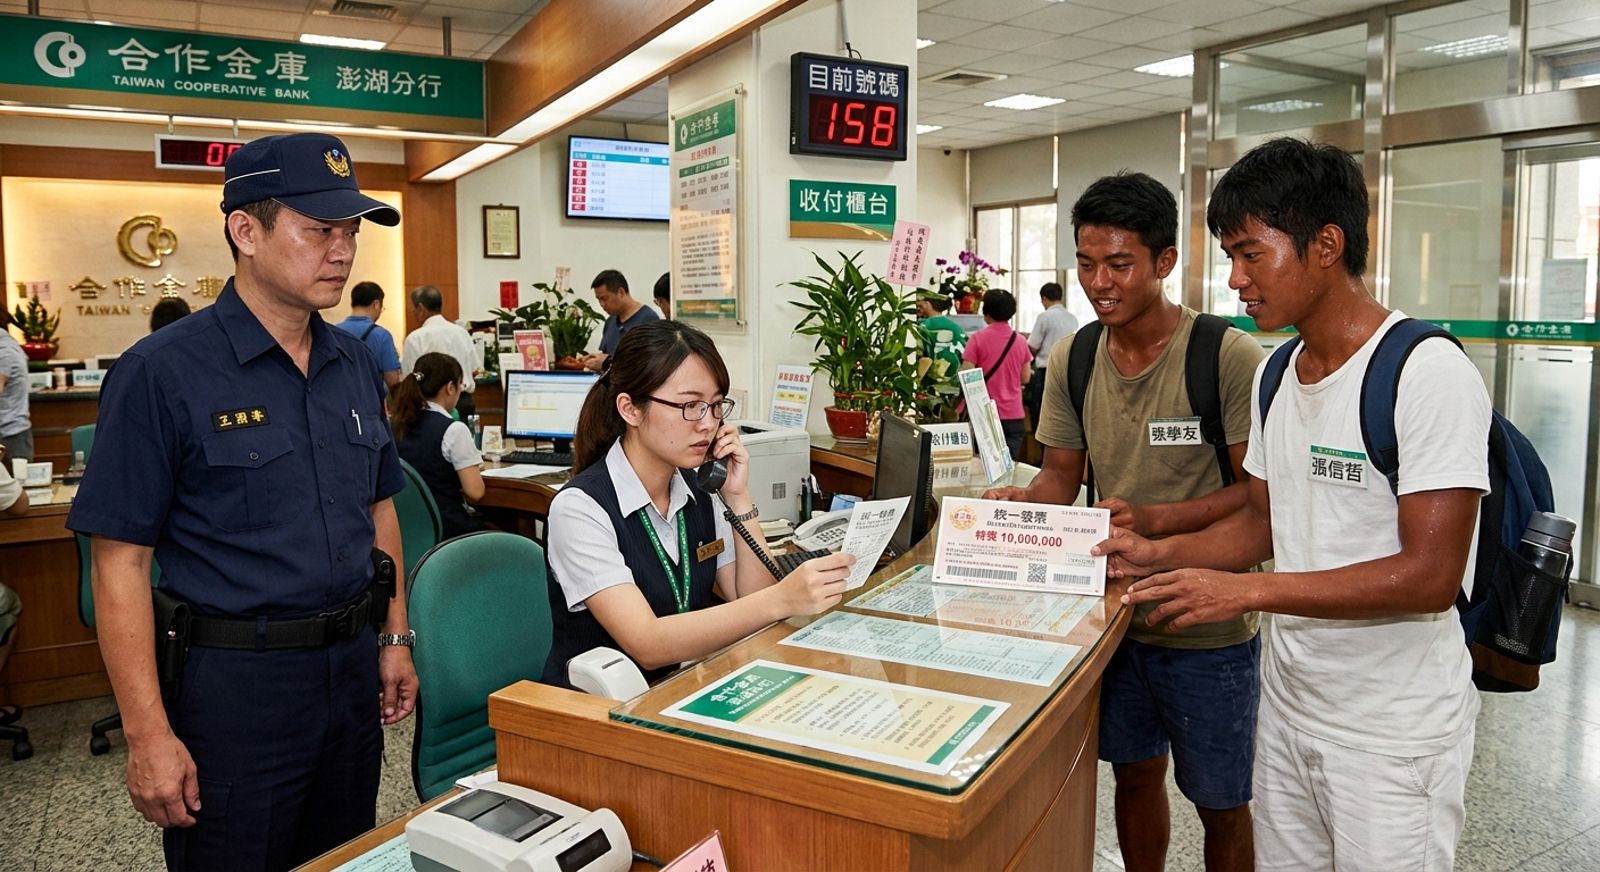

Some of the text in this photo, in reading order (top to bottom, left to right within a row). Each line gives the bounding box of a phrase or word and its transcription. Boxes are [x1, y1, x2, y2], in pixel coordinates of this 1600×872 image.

[107, 37, 442, 98] 合作金庫 澎湖分行
[808, 63, 900, 98] 目前號碼
[111, 75, 310, 100] TAIWAN COOPERATIVE BANK
[827, 102, 897, 147] 158
[799, 188, 888, 216] 收付櫃台
[77, 305, 131, 316] TAIWAN
[1311, 456, 1364, 483] 張信哲
[1000, 532, 1063, 548] 10,000,000
